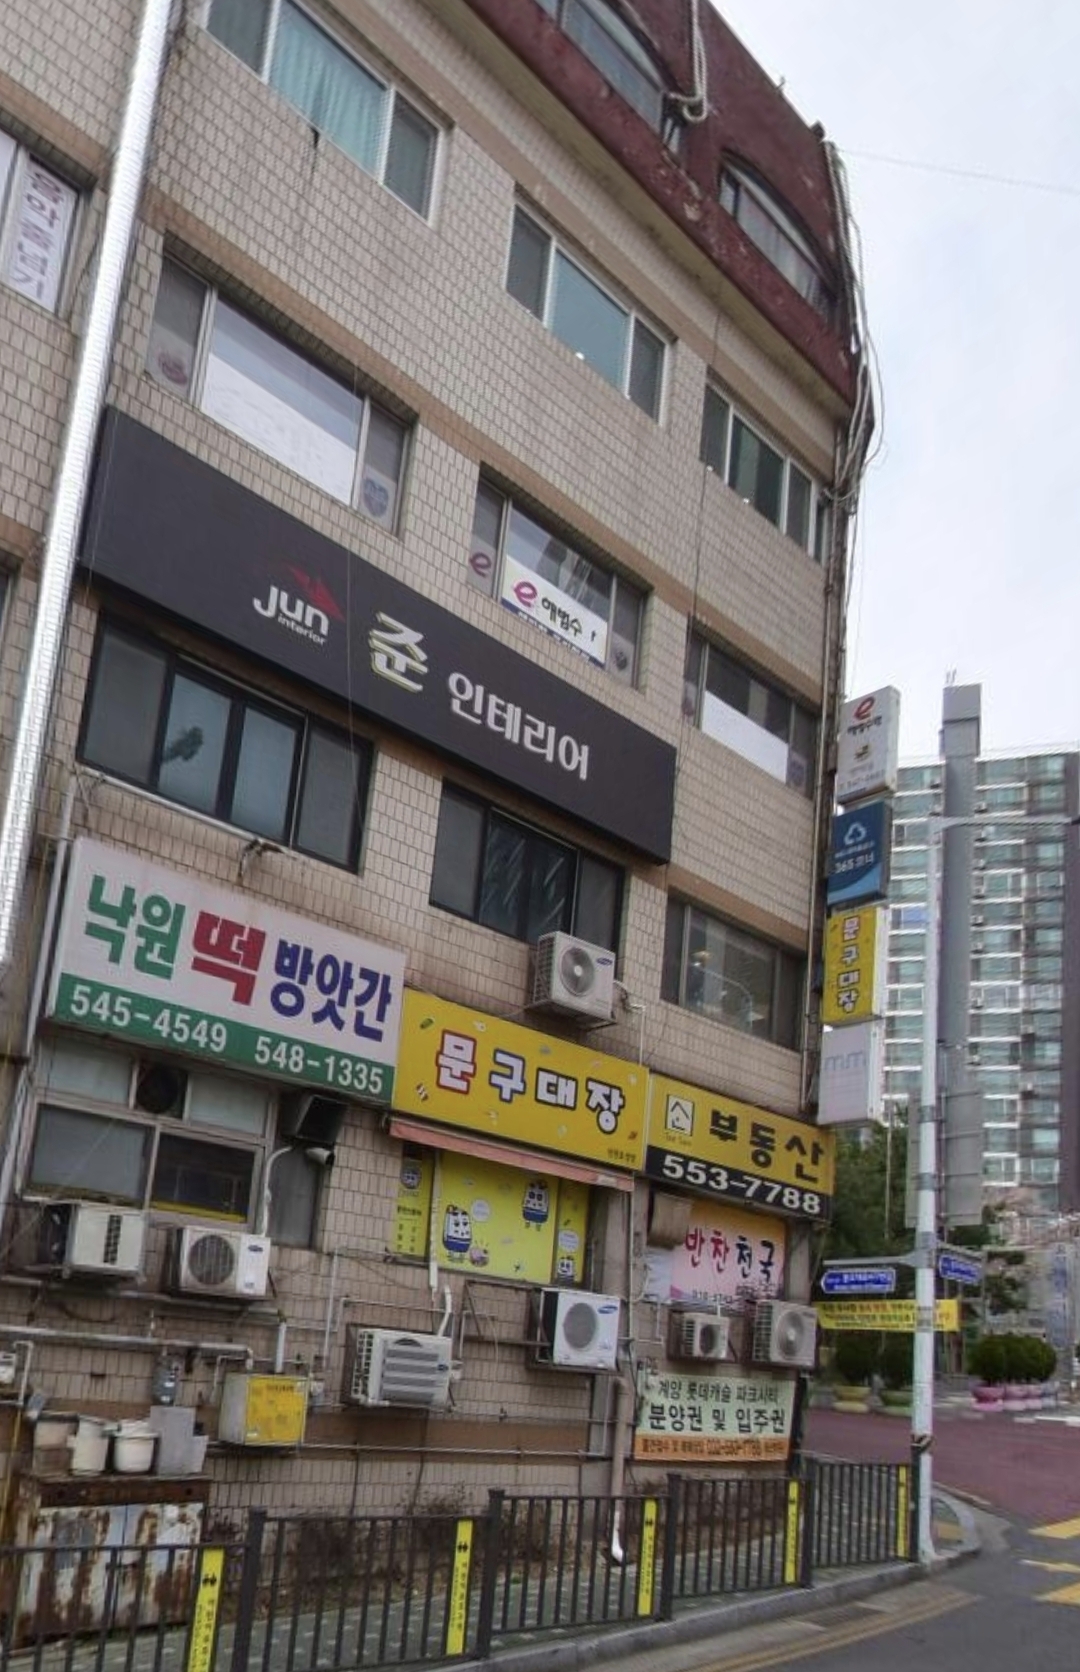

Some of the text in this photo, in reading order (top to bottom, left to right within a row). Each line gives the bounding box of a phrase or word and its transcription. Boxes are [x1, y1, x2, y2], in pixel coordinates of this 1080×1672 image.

[277, 613, 327, 645] interior
[368, 611, 428, 693] 준
[448, 672, 588, 781] 인테리어
[84, 874, 392, 1043] 낙원 떡 방앗간
[70, 984, 383, 1095] 545-4549 548-1335
[436, 1029, 625, 1135] 문구대장
[662, 1154, 820, 1214] 553-7788
[709, 1108, 825, 1184] 부동산
[648, 1403, 786, 1434] 분양권 및 입주권
